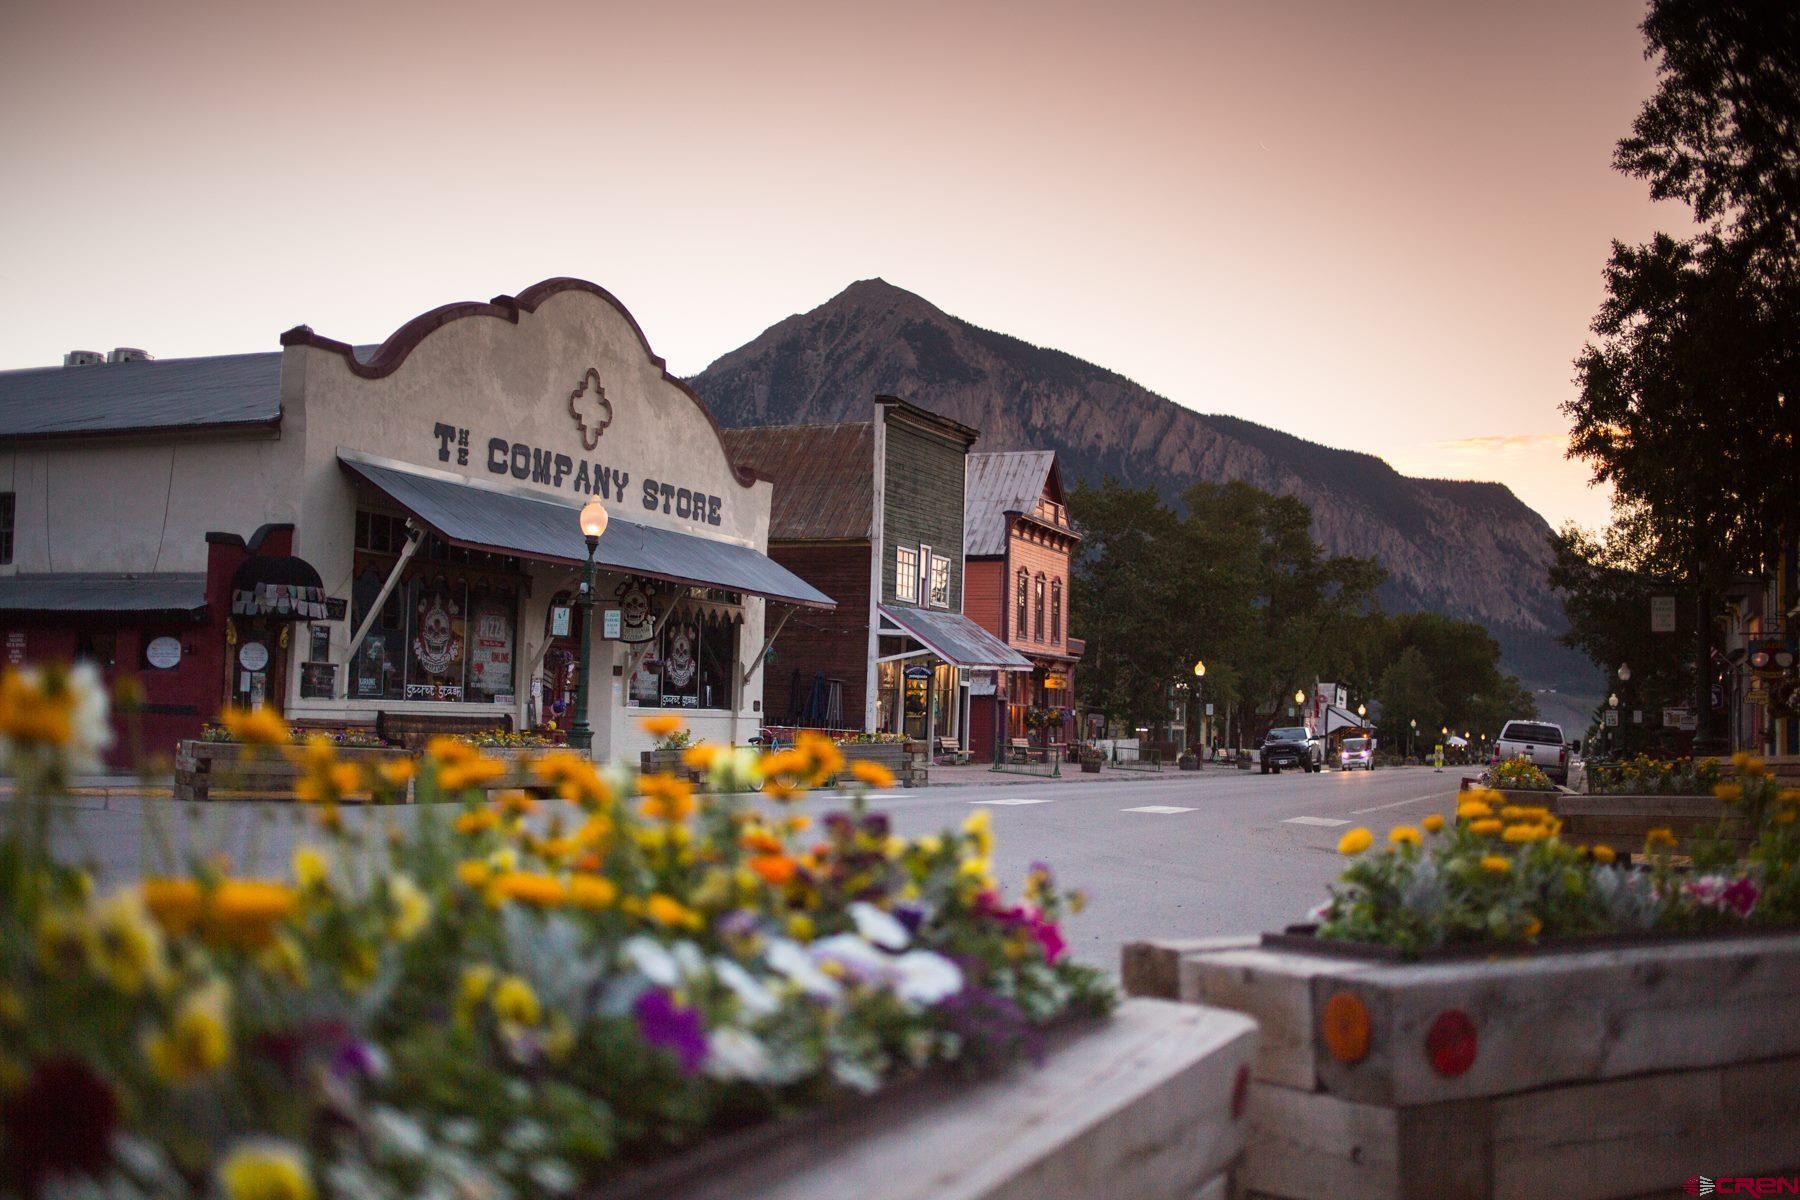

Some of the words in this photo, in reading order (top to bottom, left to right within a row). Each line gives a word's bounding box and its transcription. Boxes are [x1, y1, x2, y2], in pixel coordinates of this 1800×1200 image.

[434, 422, 470, 466] THE
[487, 436, 630, 503] COMPANY
[642, 479, 722, 526] STORE
